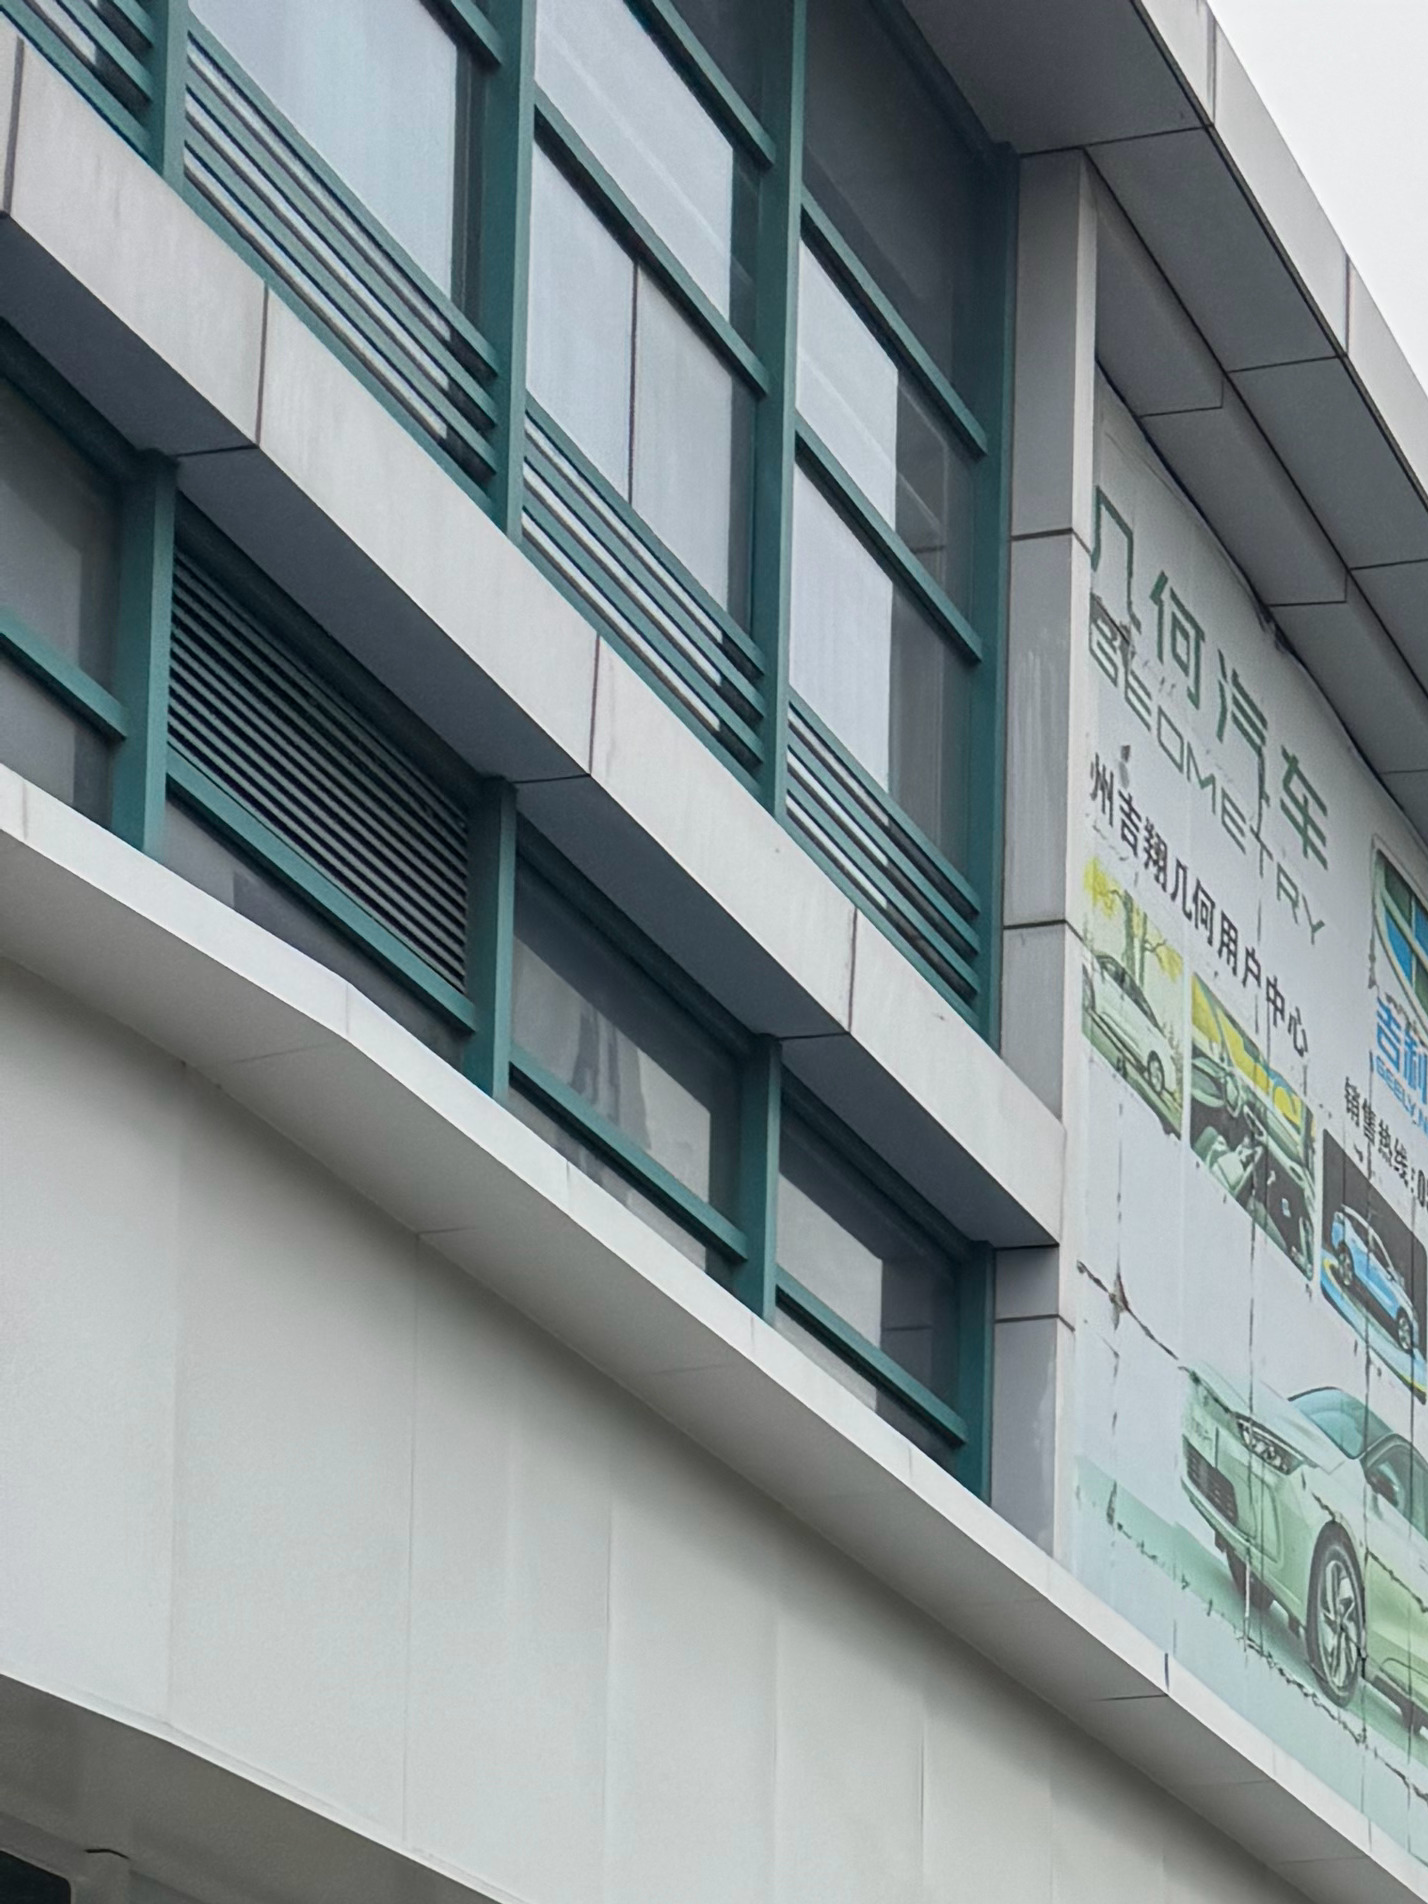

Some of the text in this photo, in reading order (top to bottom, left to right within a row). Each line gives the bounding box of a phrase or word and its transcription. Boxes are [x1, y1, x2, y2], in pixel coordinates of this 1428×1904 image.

[1089, 485, 1328, 871] 几何汽车
[1089, 592, 1325, 945] GEOMETRY
